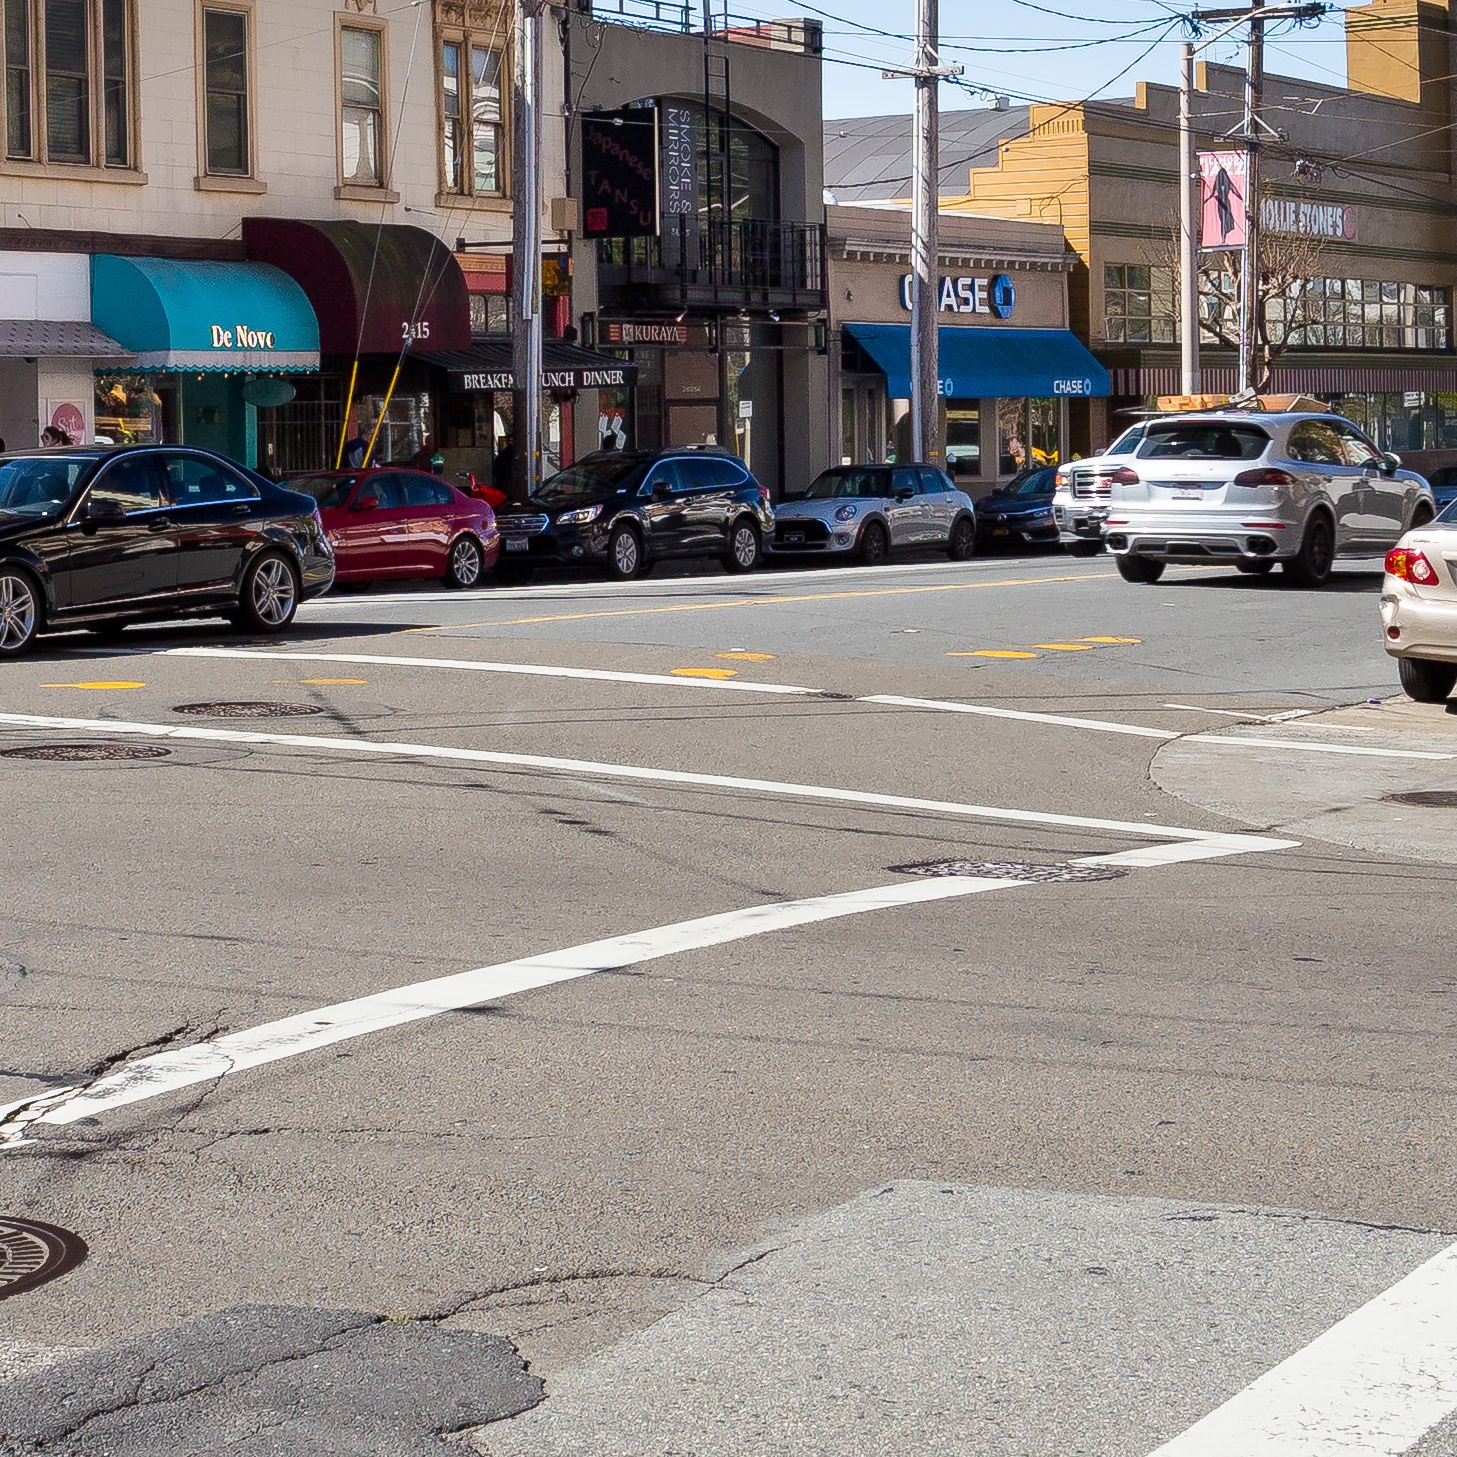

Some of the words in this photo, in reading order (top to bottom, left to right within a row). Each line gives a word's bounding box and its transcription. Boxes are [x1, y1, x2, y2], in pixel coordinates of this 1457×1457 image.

[586, 125, 652, 180] Japanese
[588, 171, 651, 225] TANSU
[904, 274, 990, 313] CASE
[211, 324, 232, 347] De
[635, 324, 679, 341] KURAYA
[464, 372, 514, 389] BREAKFA
[542, 372, 574, 386] UNCH
[583, 371, 624, 385] DINNER
[1054, 379, 1083, 394] CHASE
